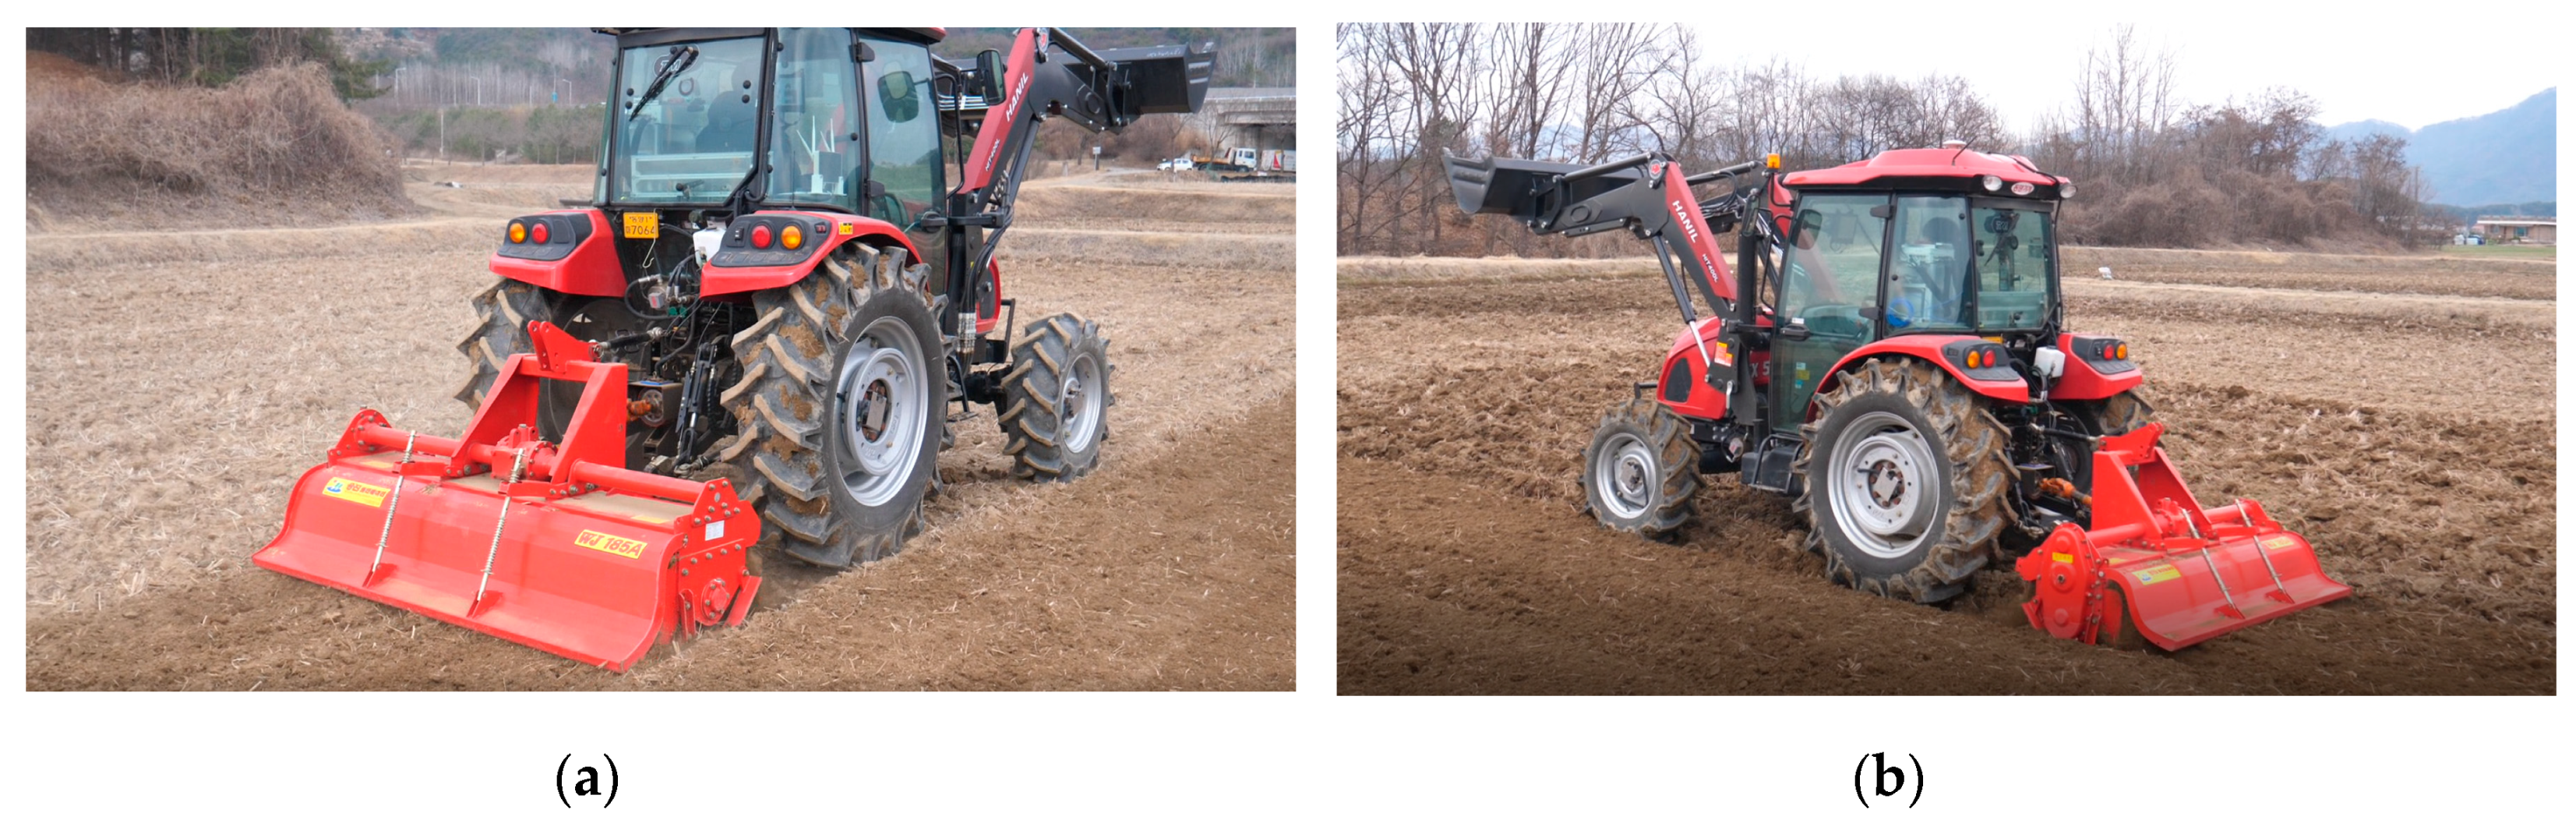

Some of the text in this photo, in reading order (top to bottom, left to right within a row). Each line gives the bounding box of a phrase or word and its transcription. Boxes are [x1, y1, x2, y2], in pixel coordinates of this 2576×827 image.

[1006, 72, 1029, 122] HANIL
[1672, 200, 1698, 243] HANIL
[578, 532, 643, 557] WJ 185A
